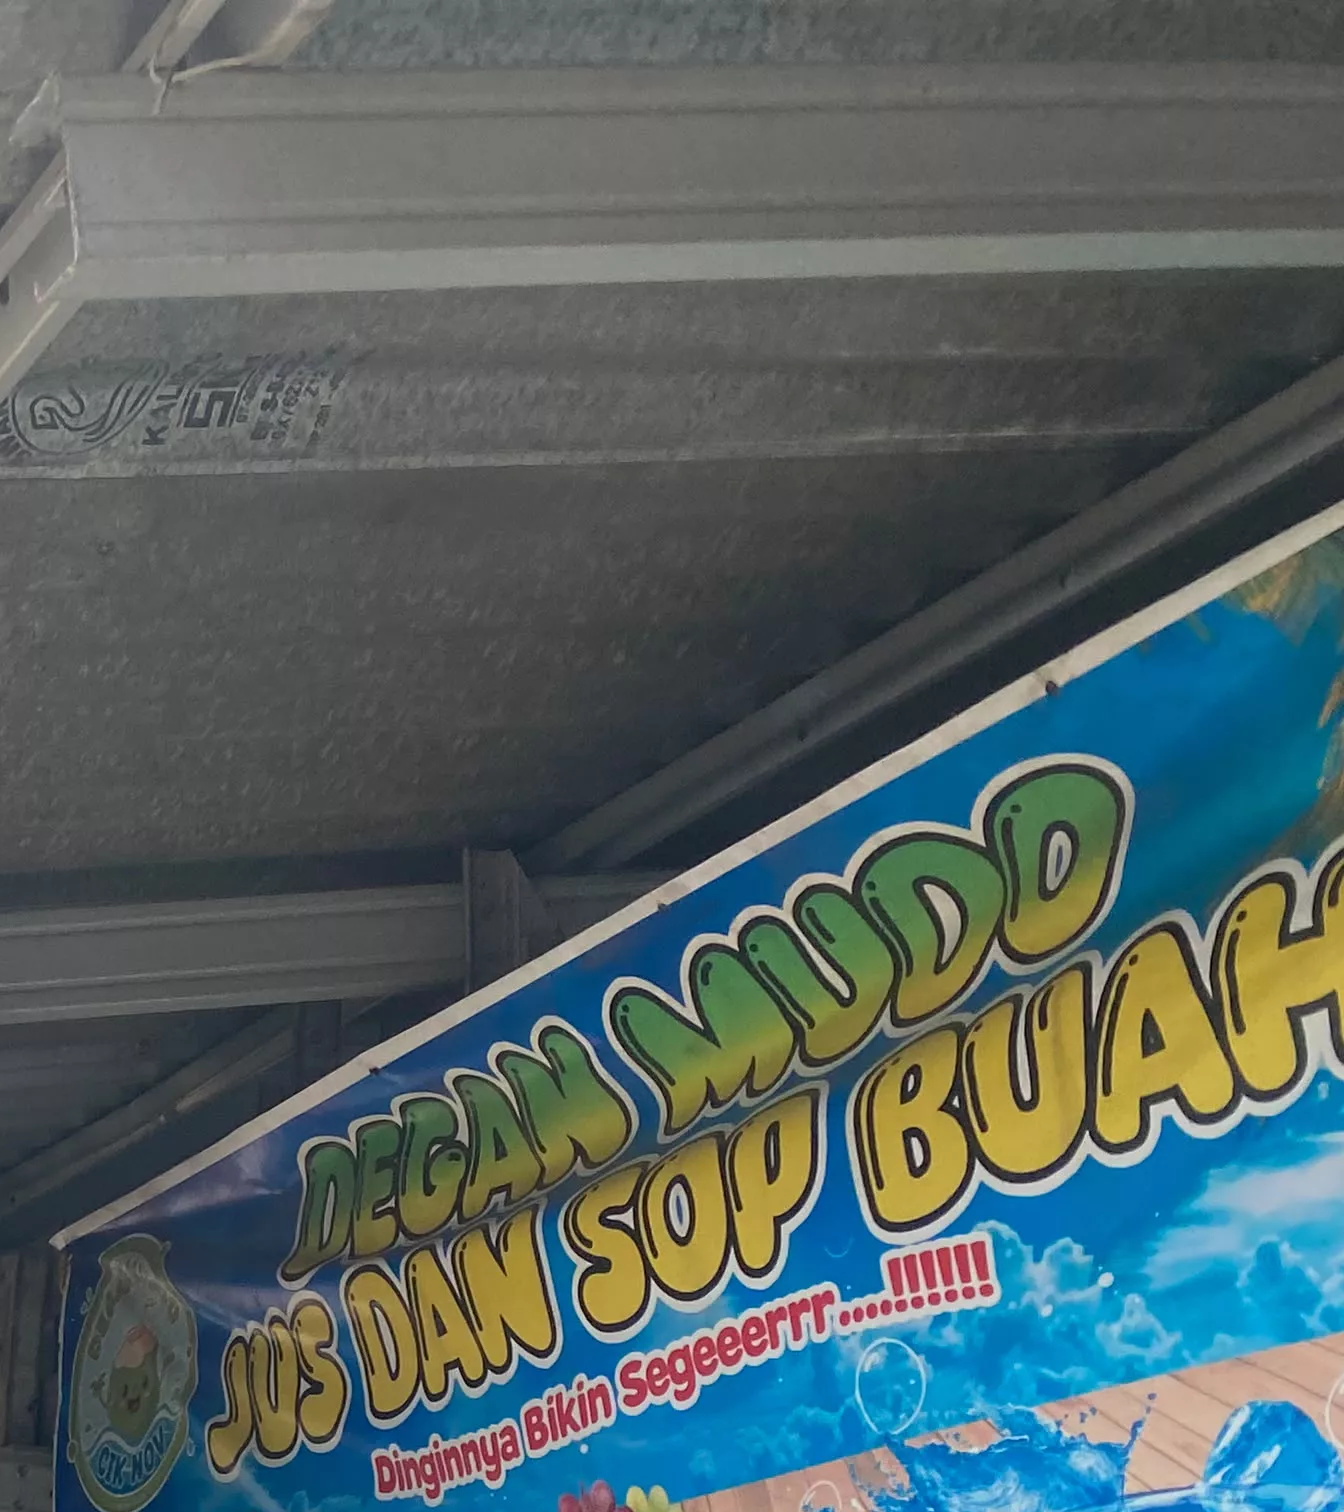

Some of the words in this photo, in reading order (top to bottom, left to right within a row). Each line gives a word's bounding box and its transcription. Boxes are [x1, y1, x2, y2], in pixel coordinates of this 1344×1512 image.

[211, 1299, 348, 1475] JUS
[344, 1206, 558, 1419] DAN
[565, 1088, 821, 1332] SOP
[853, 852, 1344, 1232] BUAH
[282, 1030, 633, 1279] DEGAN
[612, 764, 1126, 1135] MUDO
[376, 1426, 519, 1498] Dinginnya
[524, 1376, 613, 1451] Bikin
